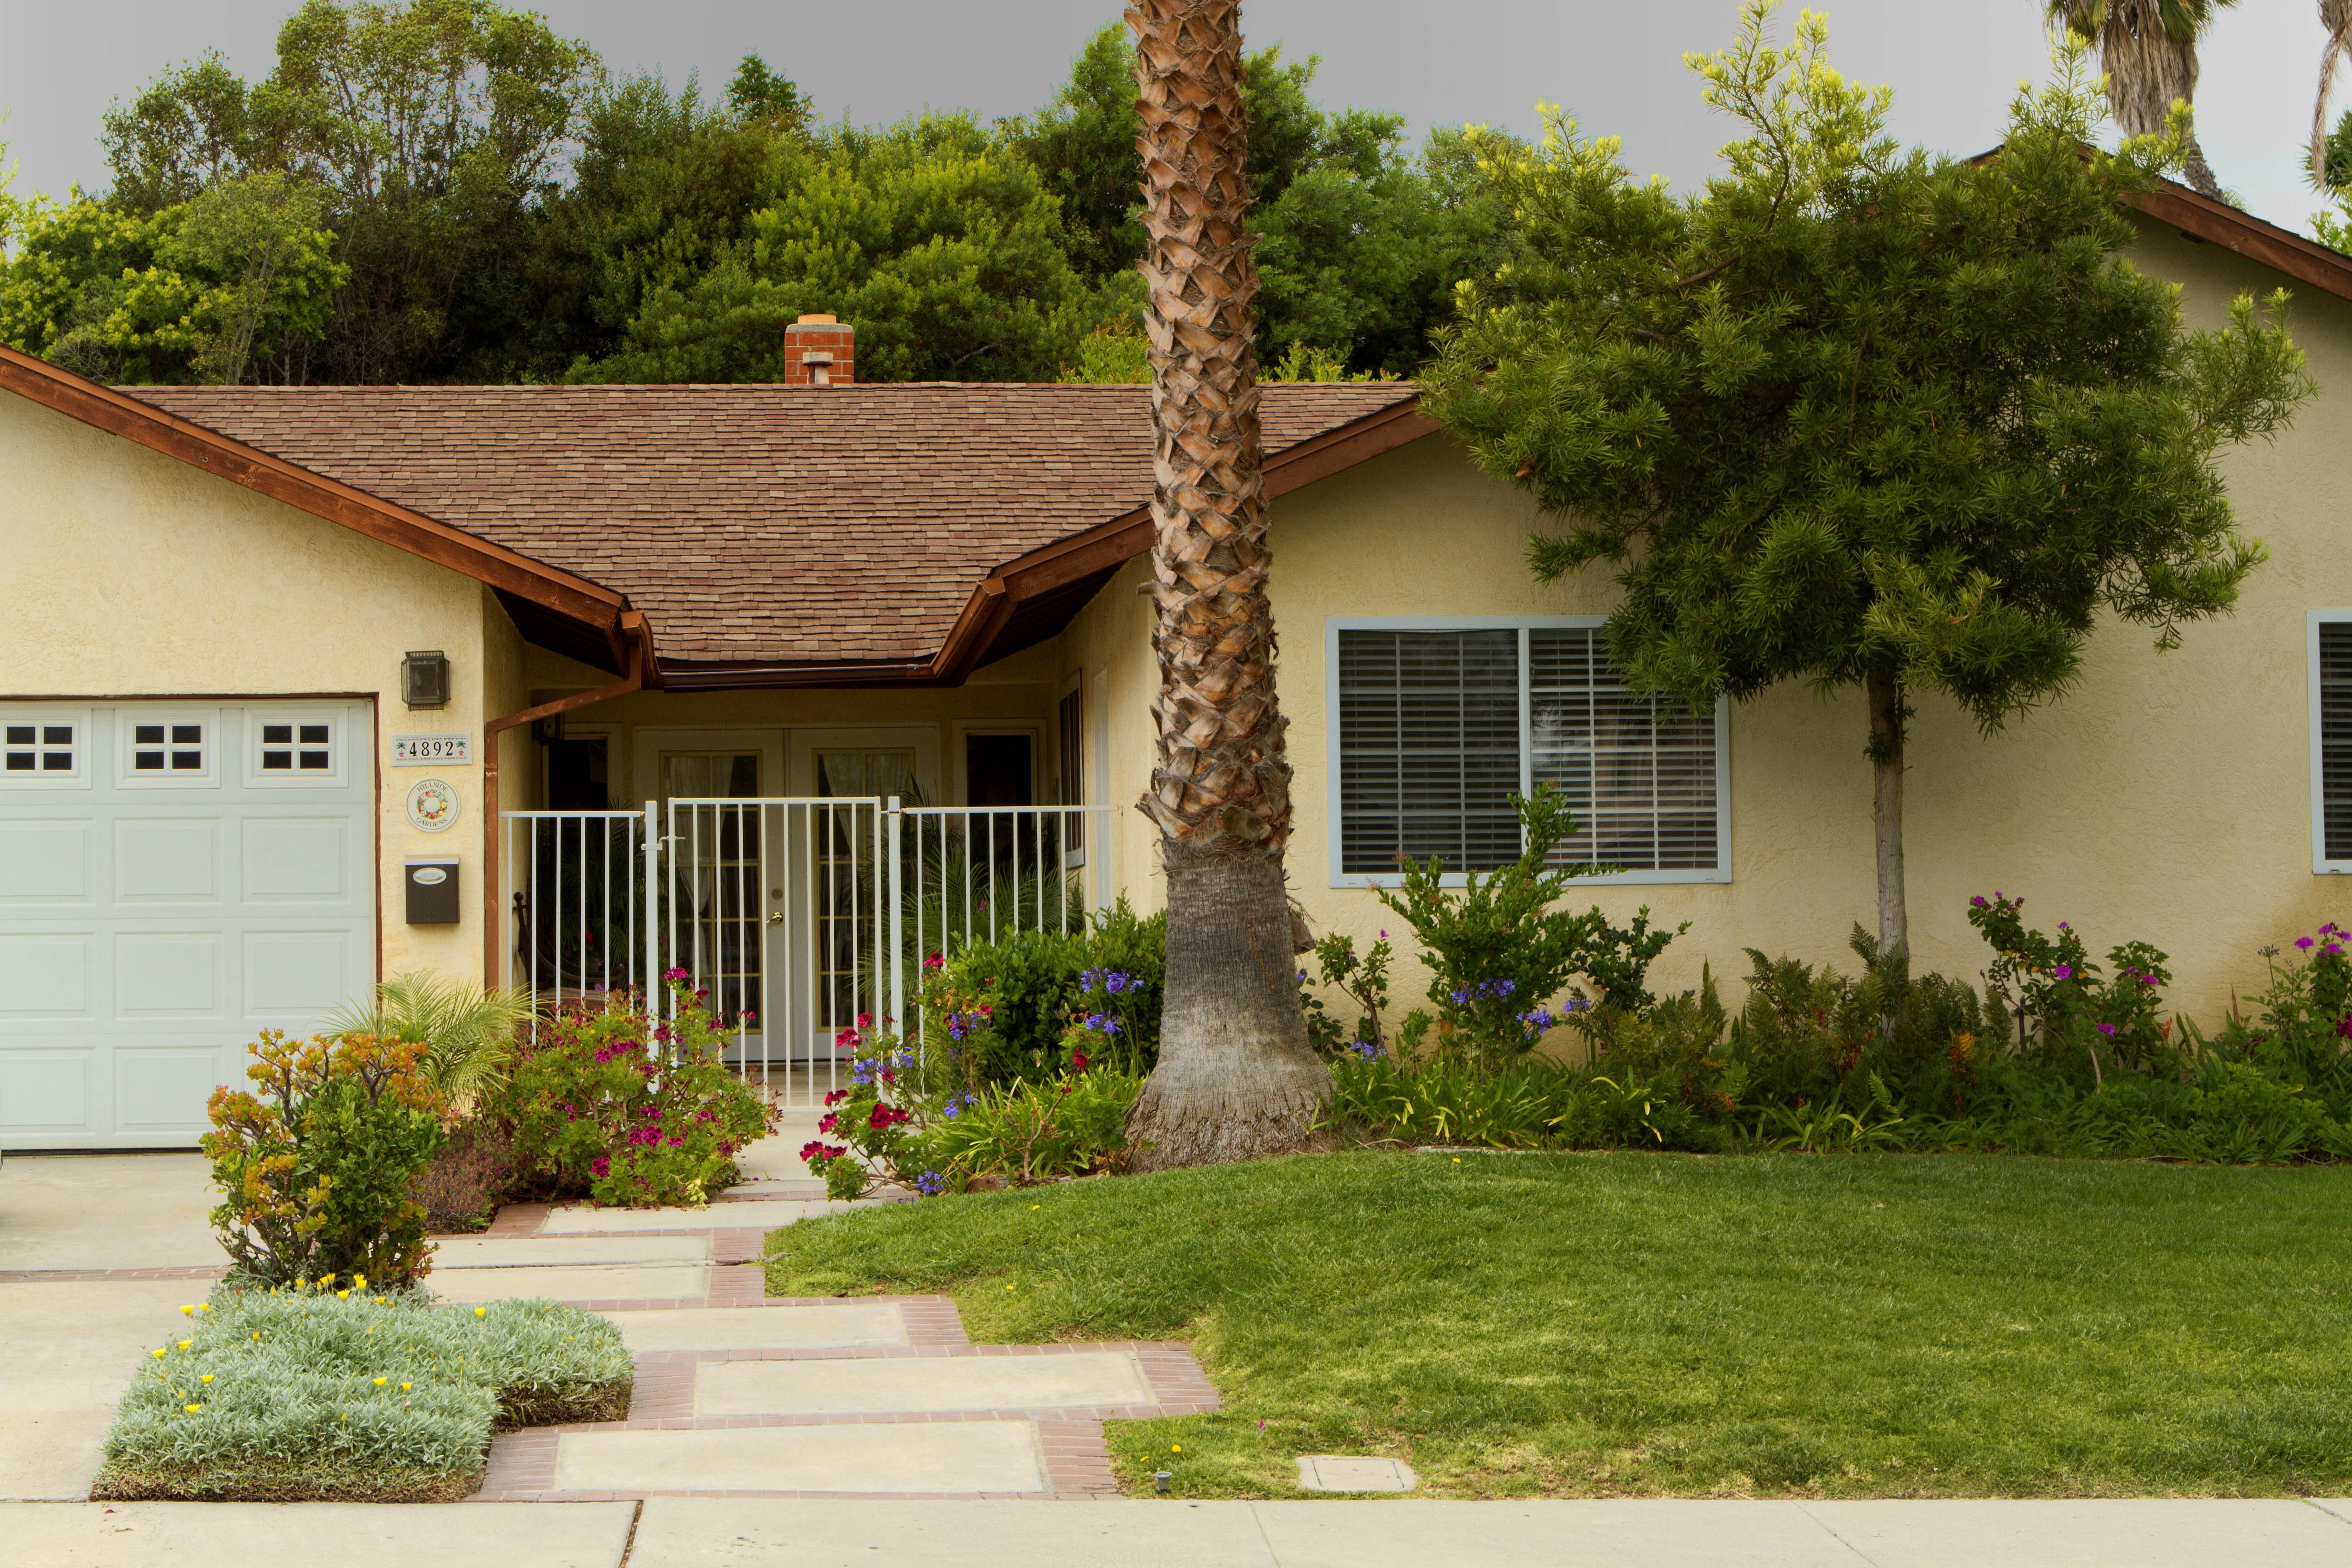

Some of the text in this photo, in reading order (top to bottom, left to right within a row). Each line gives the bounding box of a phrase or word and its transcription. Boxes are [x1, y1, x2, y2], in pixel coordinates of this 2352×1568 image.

[410, 742, 453, 757] 4892
[416, 781, 449, 792] HILLSIDE
[416, 817, 448, 828] GARDENS
